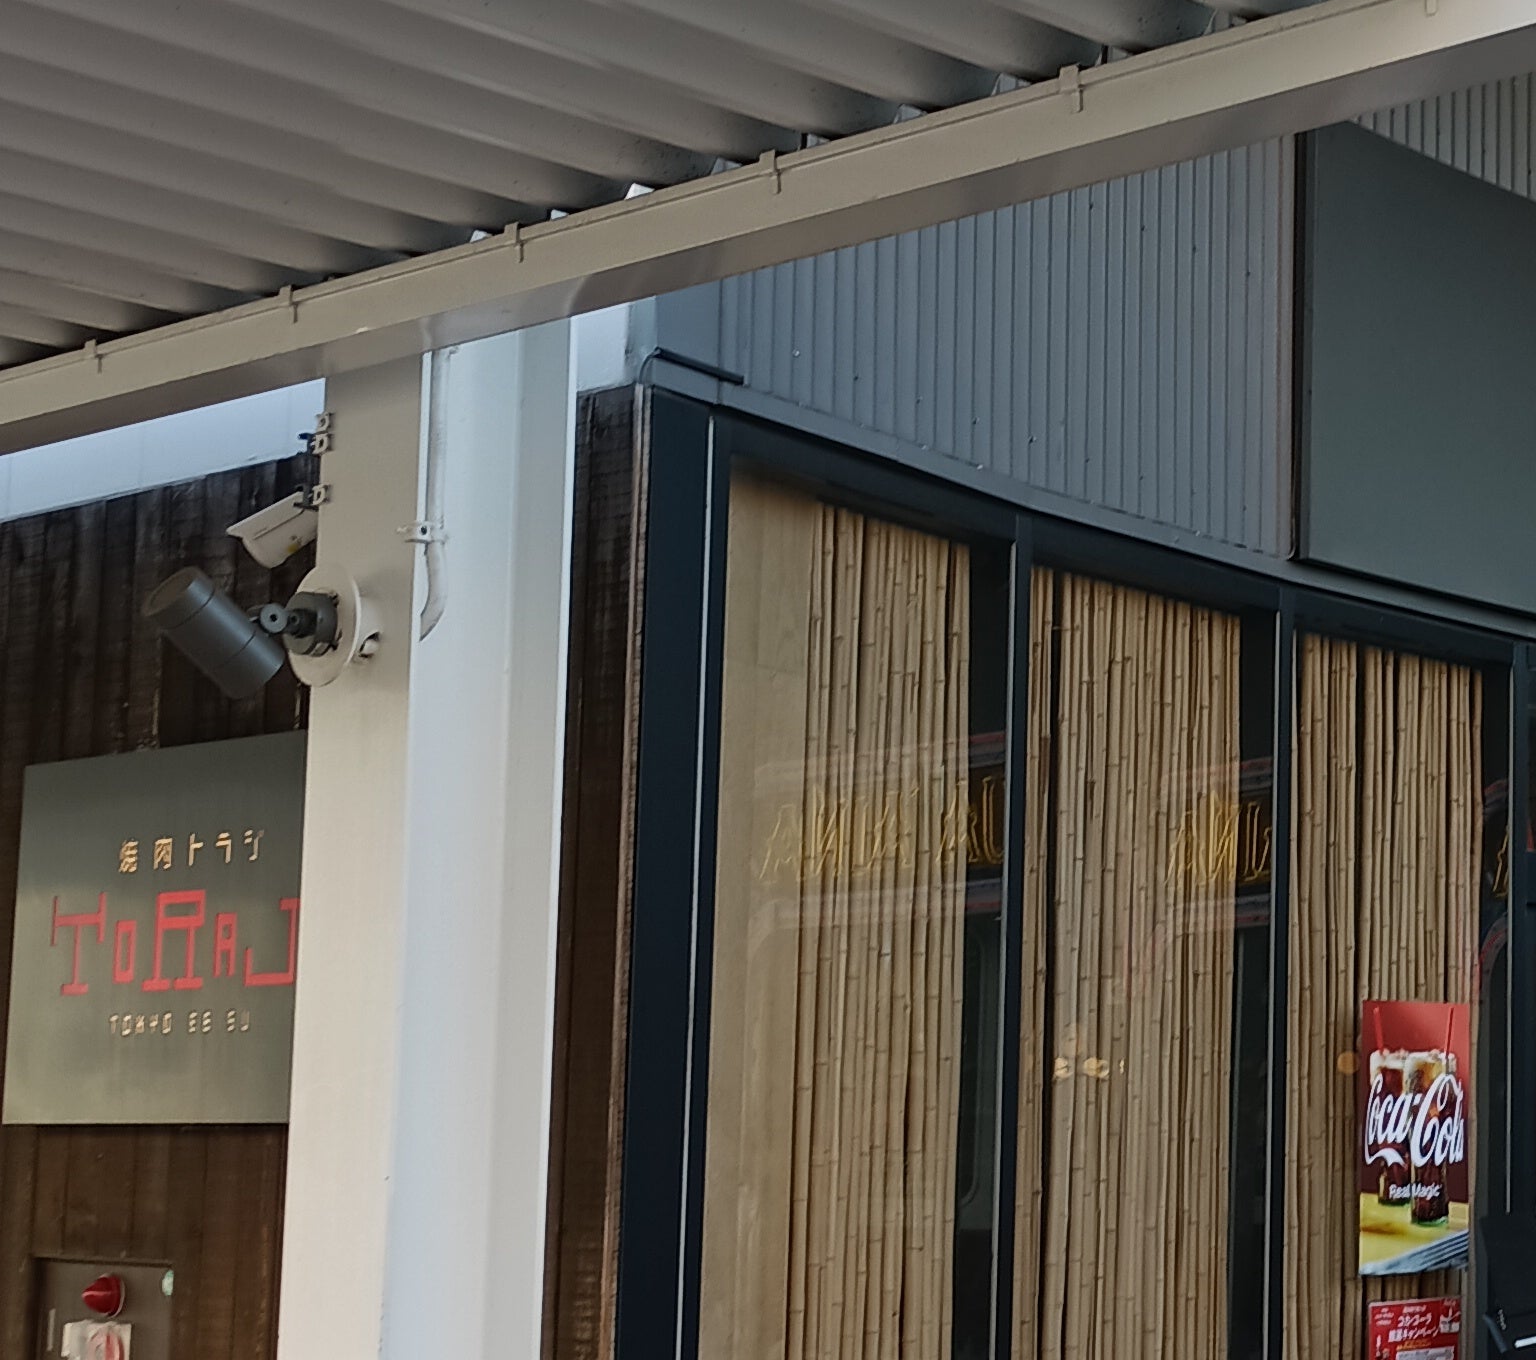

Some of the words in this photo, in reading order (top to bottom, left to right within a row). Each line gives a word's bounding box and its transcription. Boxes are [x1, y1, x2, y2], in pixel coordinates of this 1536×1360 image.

[50, 889, 300, 996] TORAJ
[109, 1012, 173, 1037] TOKYO
[188, 1008, 250, 1034] EBSU
[1388, 1183, 1411, 1200] Real
[1411, 1181, 1443, 1201] Magic
